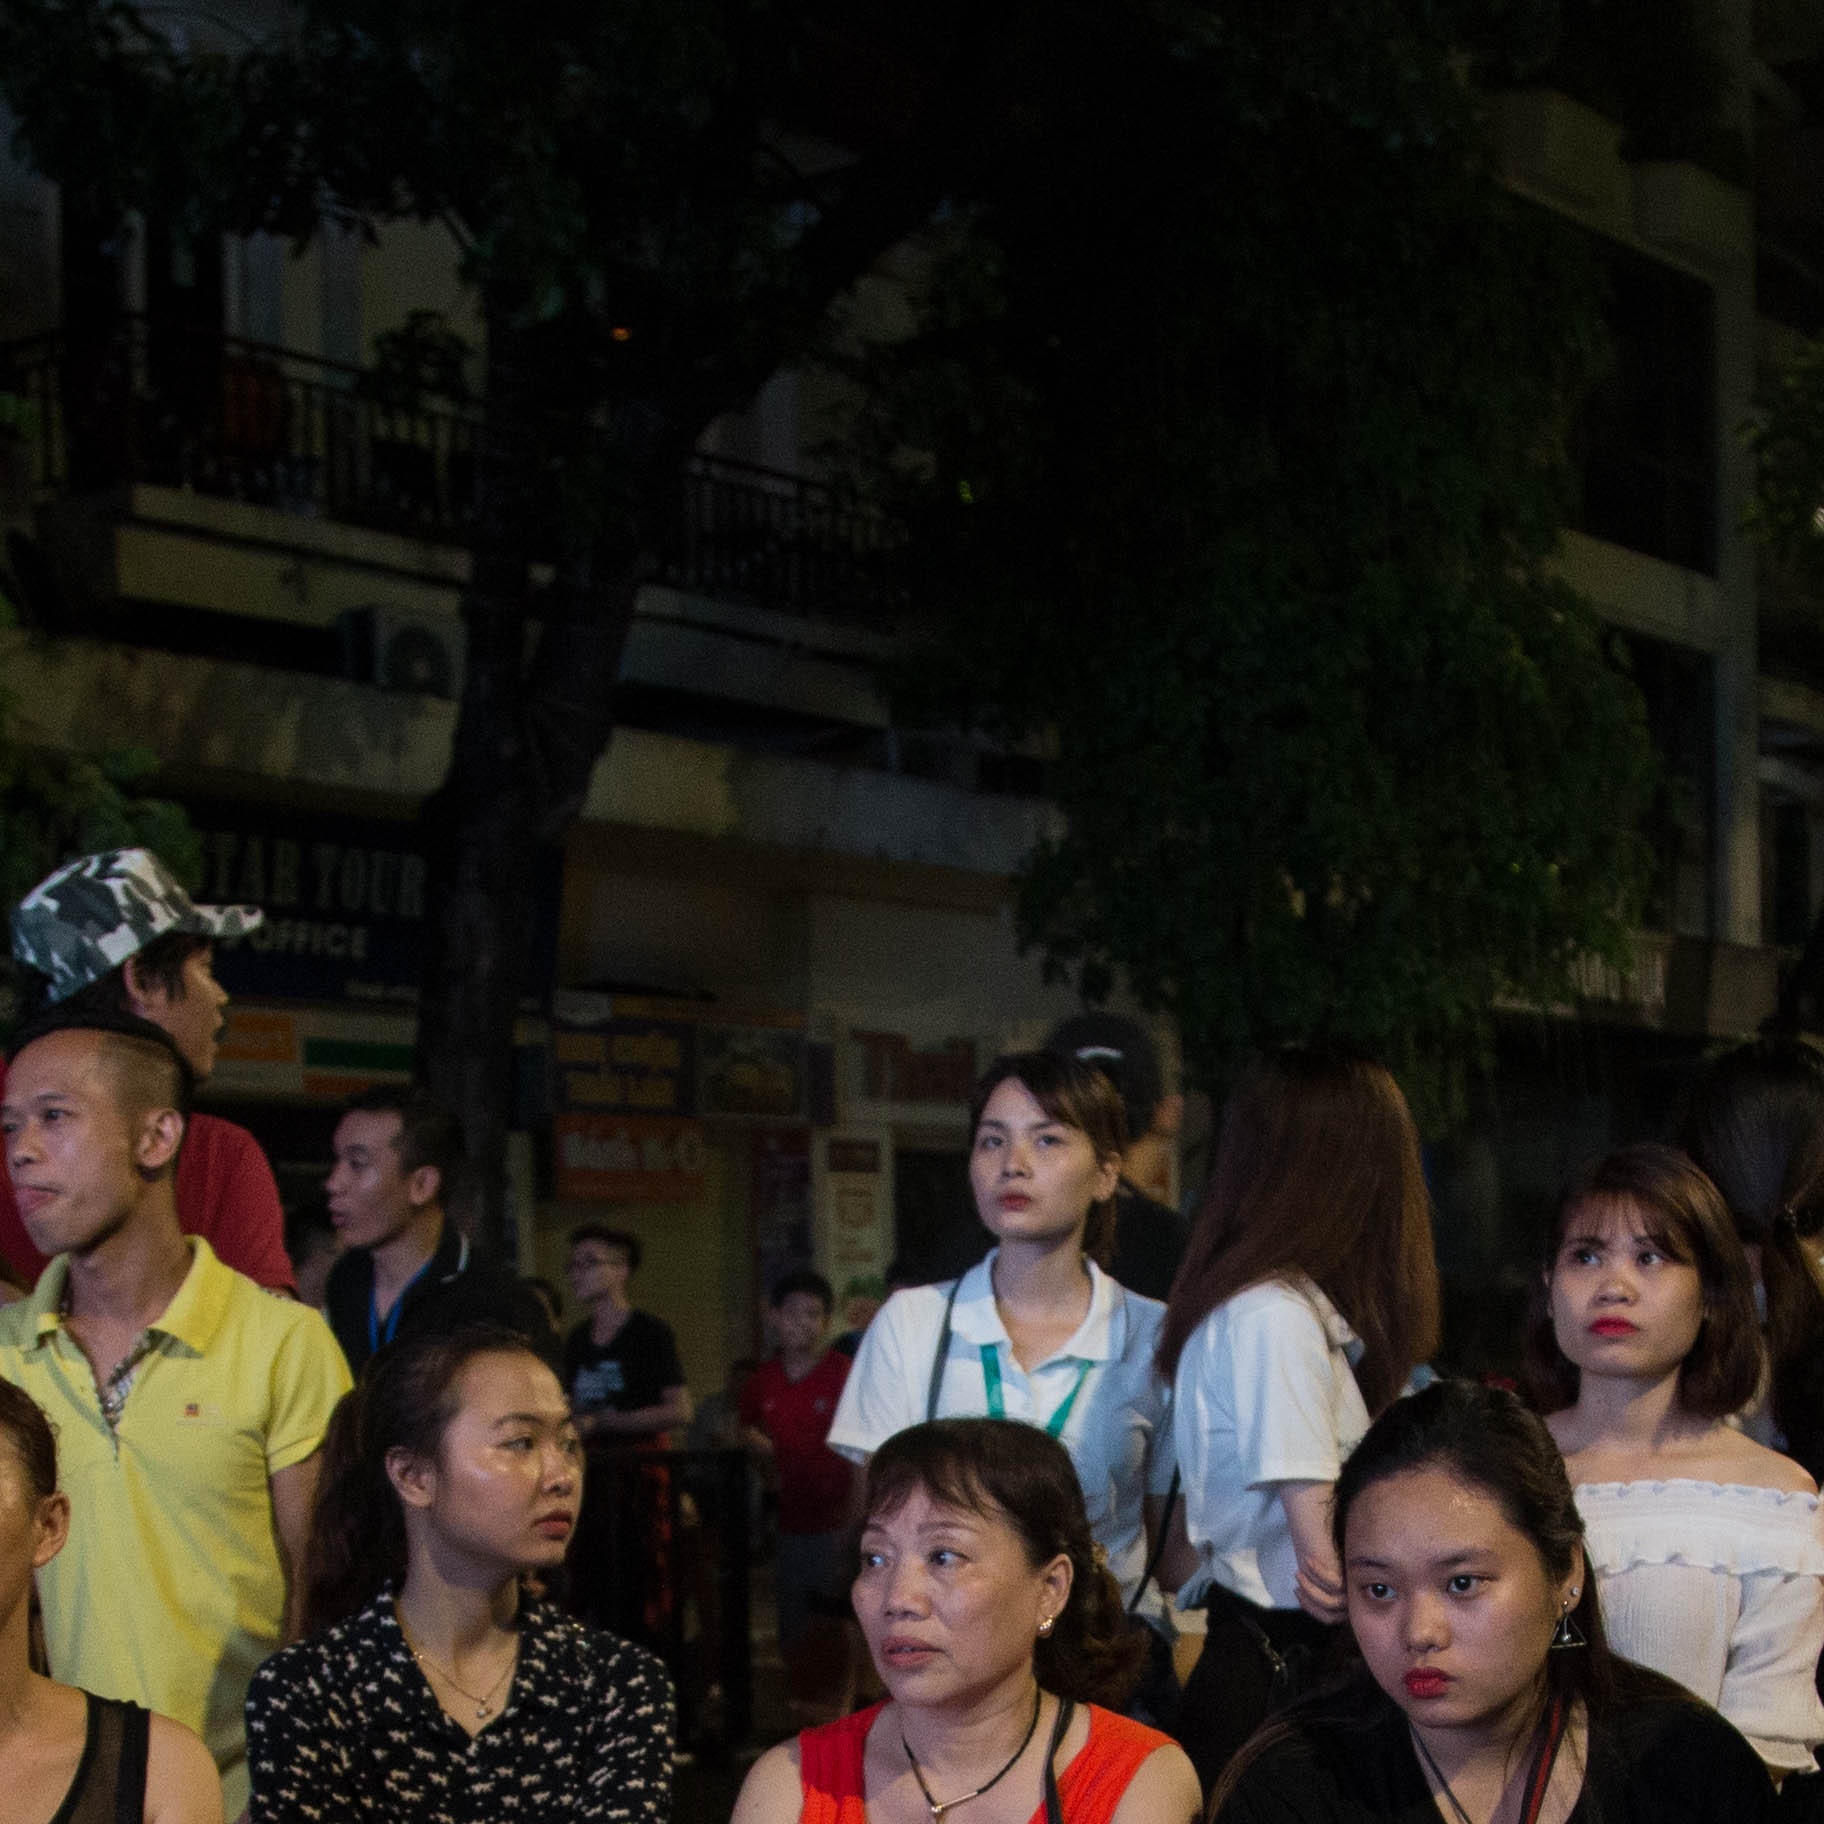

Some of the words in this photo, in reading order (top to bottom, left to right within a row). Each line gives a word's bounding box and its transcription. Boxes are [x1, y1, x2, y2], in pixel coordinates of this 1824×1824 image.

[203, 831, 303, 906] TAR
[312, 841, 428, 920] TOUR
[249, 917, 369, 961] OFFICE
